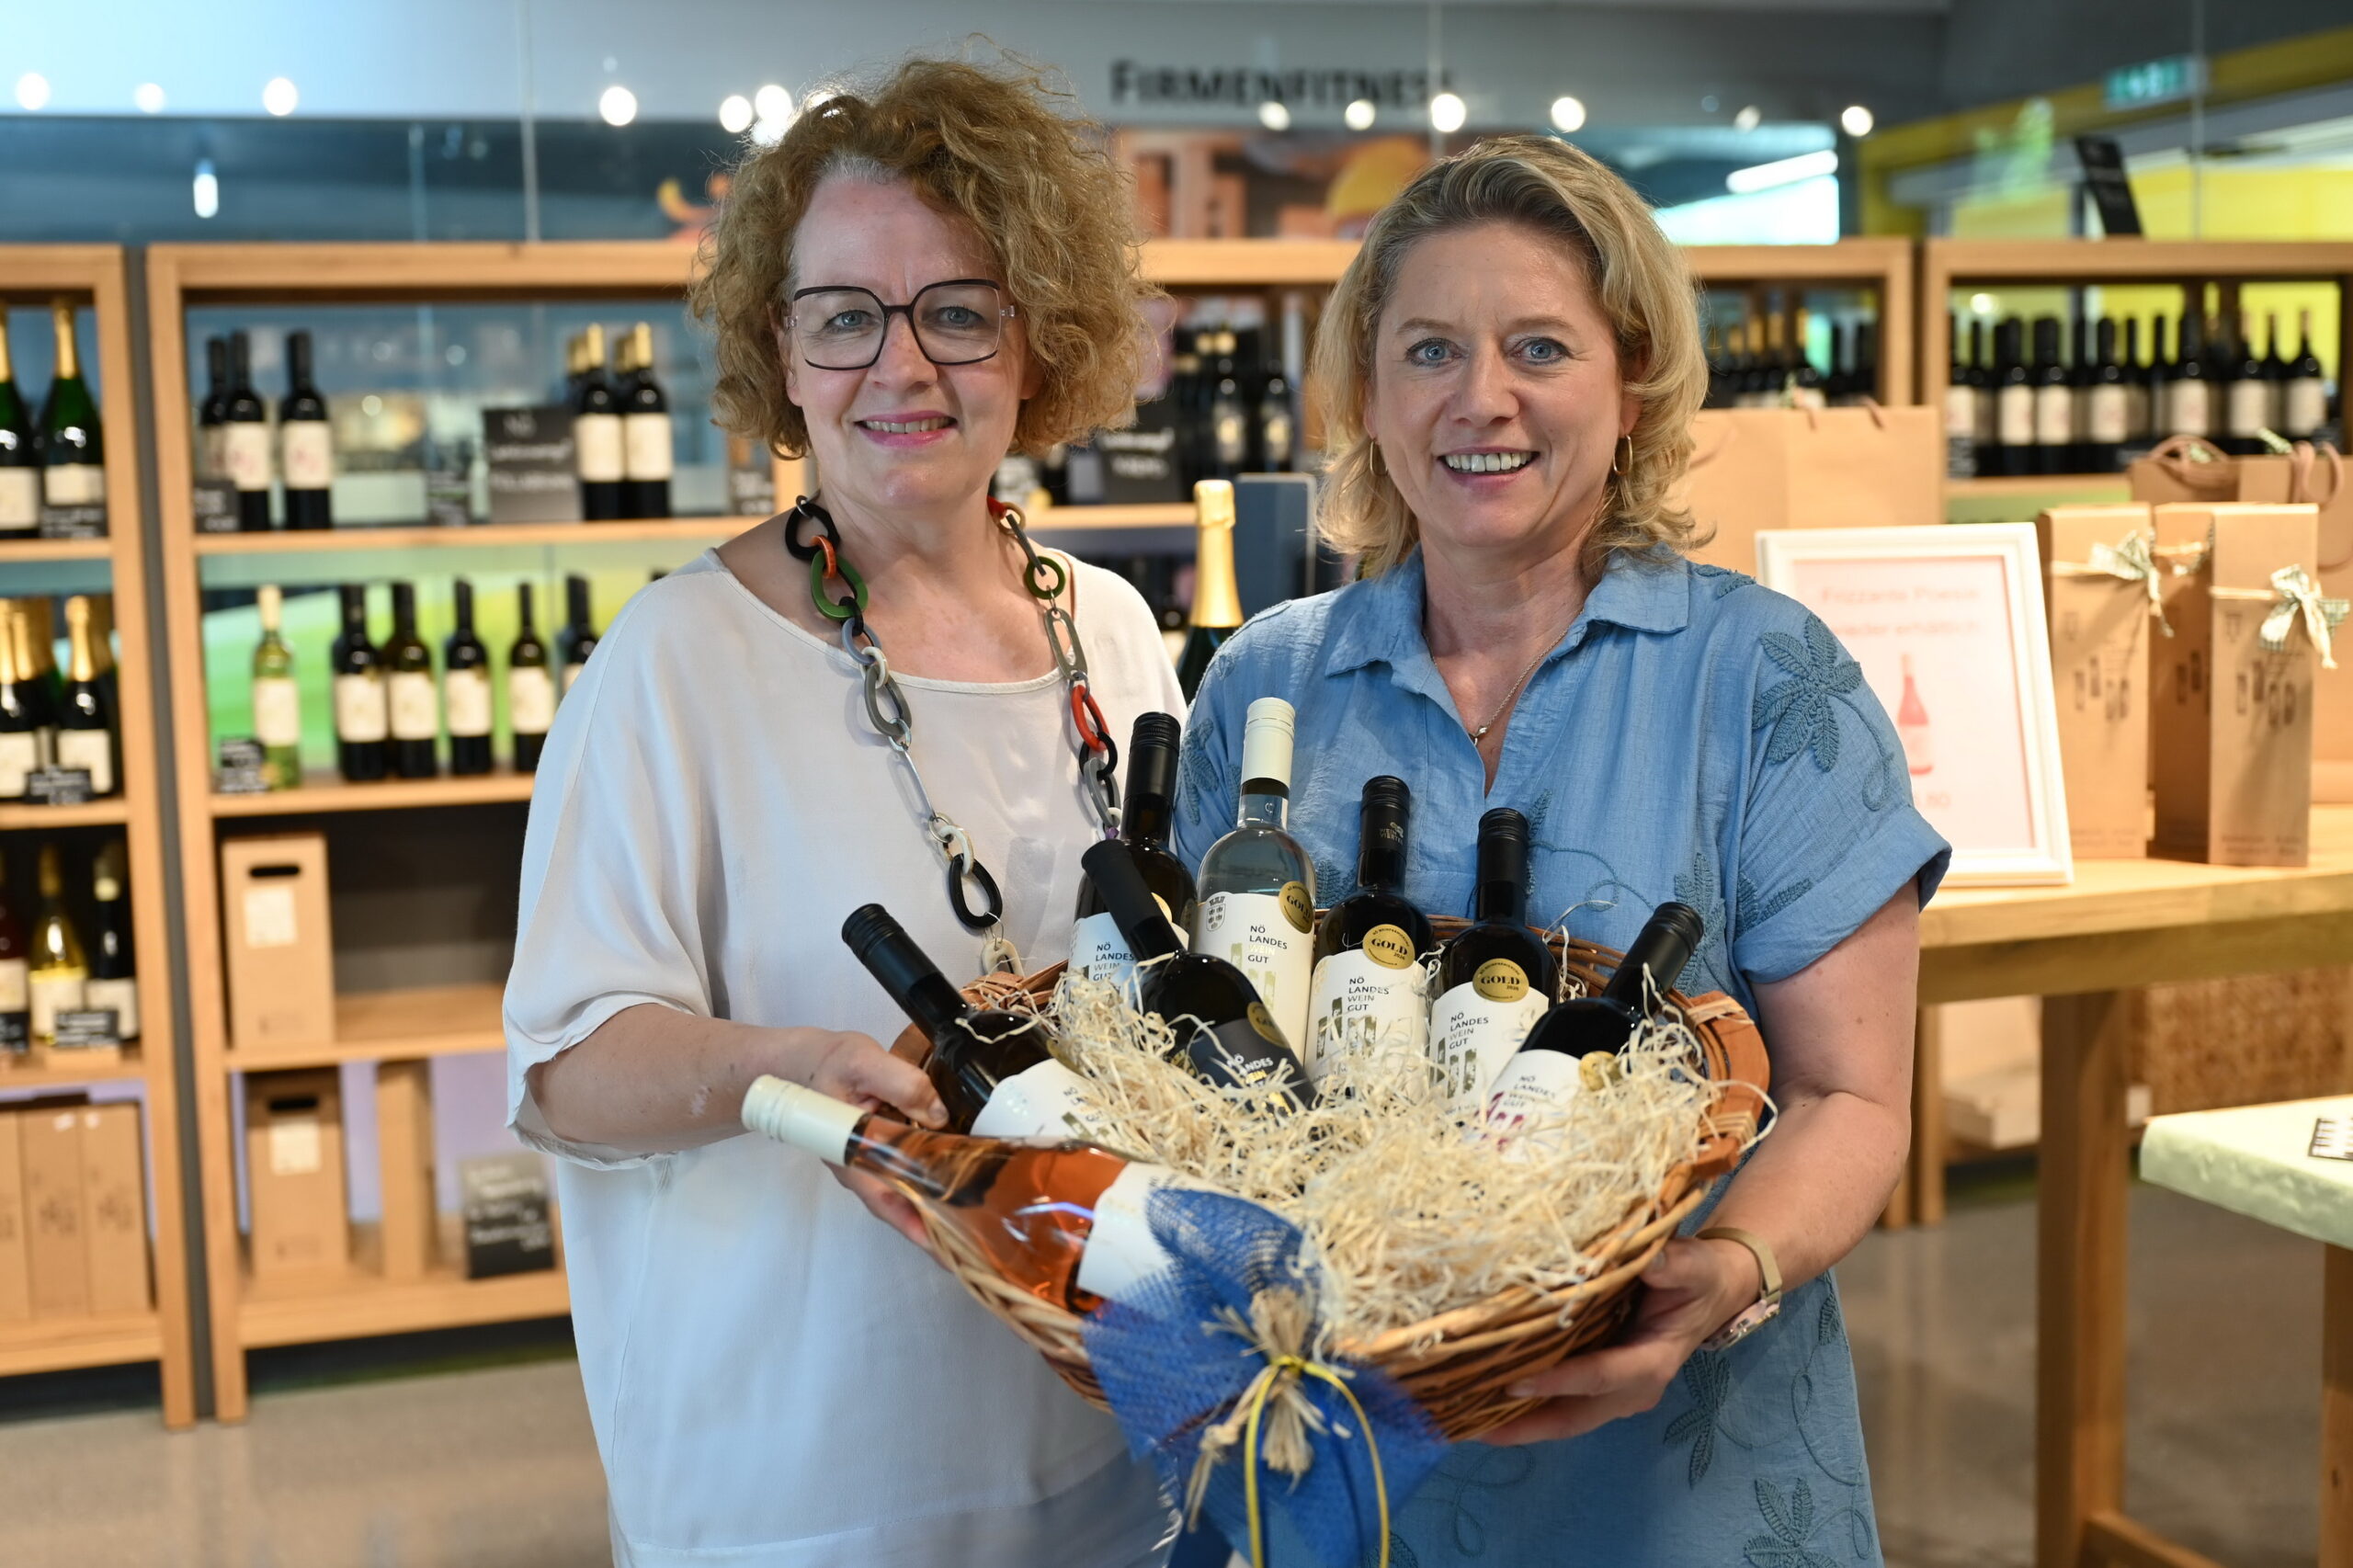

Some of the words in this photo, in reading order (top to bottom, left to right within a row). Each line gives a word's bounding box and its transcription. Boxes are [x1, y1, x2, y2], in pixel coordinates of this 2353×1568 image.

[1251, 924, 1266, 934] NÖ
[1096, 941, 1111, 952] NÖ
[1249, 935, 1288, 950] LANDES
[1371, 937, 1408, 956] GOLD
[1249, 944, 1276, 956] WEIN
[1095, 952, 1135, 962] LANDES
[1247, 954, 1269, 964] GUT
[1348, 975, 1365, 985] NÖ
[1481, 975, 1520, 986] GOLD
[1348, 985, 1390, 995] LANDES
[1347, 994, 1375, 1003] WEIN
[1347, 1004, 1370, 1012] GUT
[1450, 1010, 1464, 1023] NÖ
[1449, 1017, 1489, 1032] LANDES
[1449, 1028, 1474, 1040] WEIN
[1449, 1037, 1469, 1050] GUT
